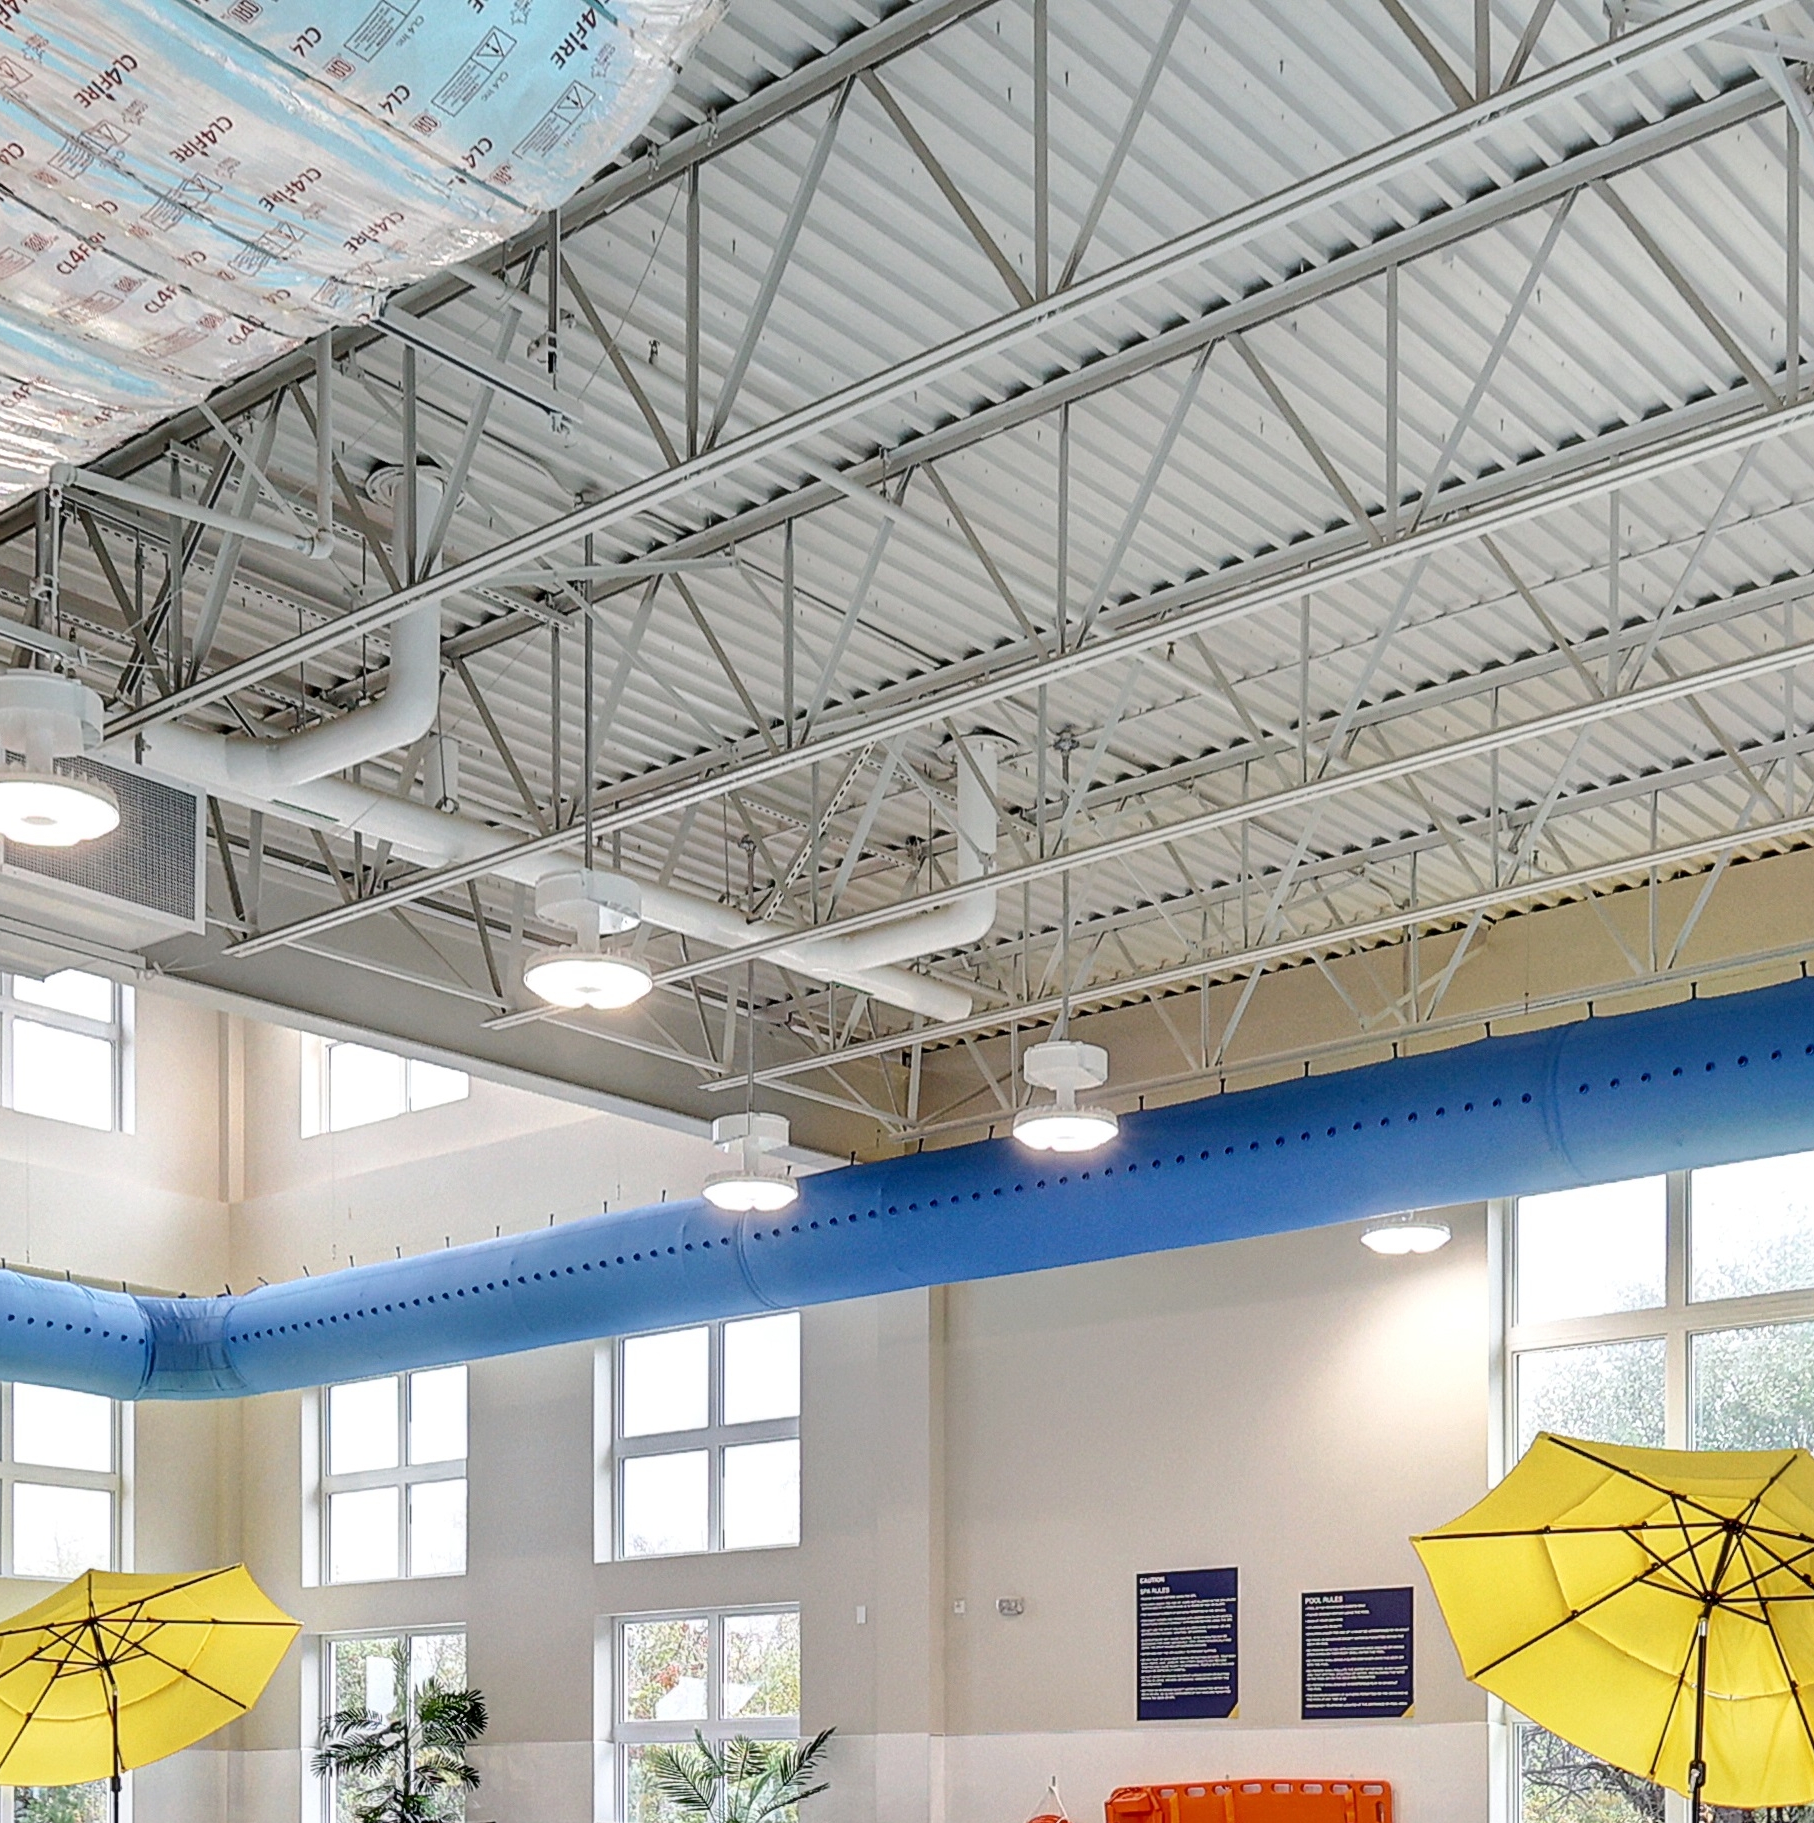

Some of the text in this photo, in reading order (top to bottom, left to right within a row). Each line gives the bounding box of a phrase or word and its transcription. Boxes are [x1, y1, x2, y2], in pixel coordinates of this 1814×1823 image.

[73, 54, 138, 109] CL4FIRE
[169, 115, 234, 164] CL4FIRE
[258, 167, 323, 212] CL4FIRE
